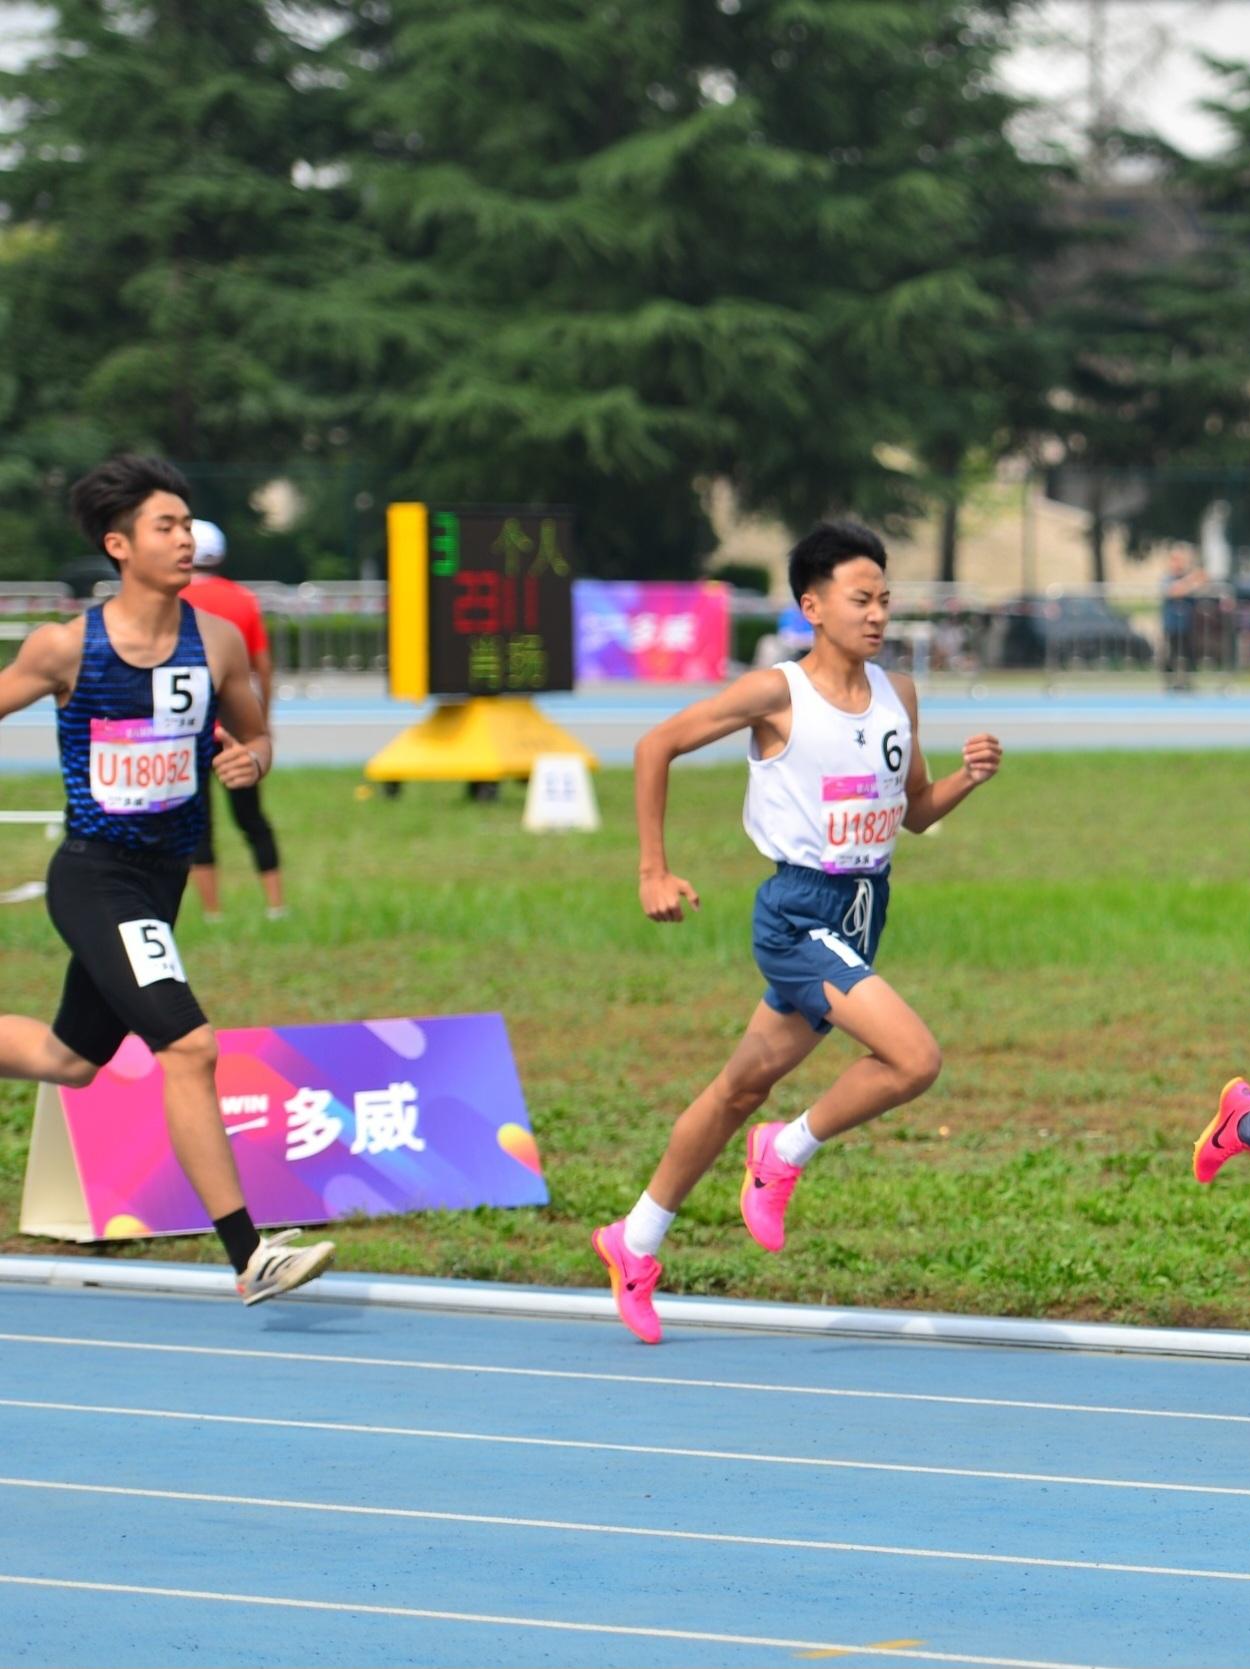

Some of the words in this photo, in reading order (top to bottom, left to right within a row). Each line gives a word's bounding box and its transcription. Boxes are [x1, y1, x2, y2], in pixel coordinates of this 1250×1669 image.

[170, 674, 193, 714] 5
[98, 750, 191, 788] U18052
[881, 729, 903, 772] 6
[139, 924, 167, 959] 5
[283, 1080, 426, 1162] 多威
